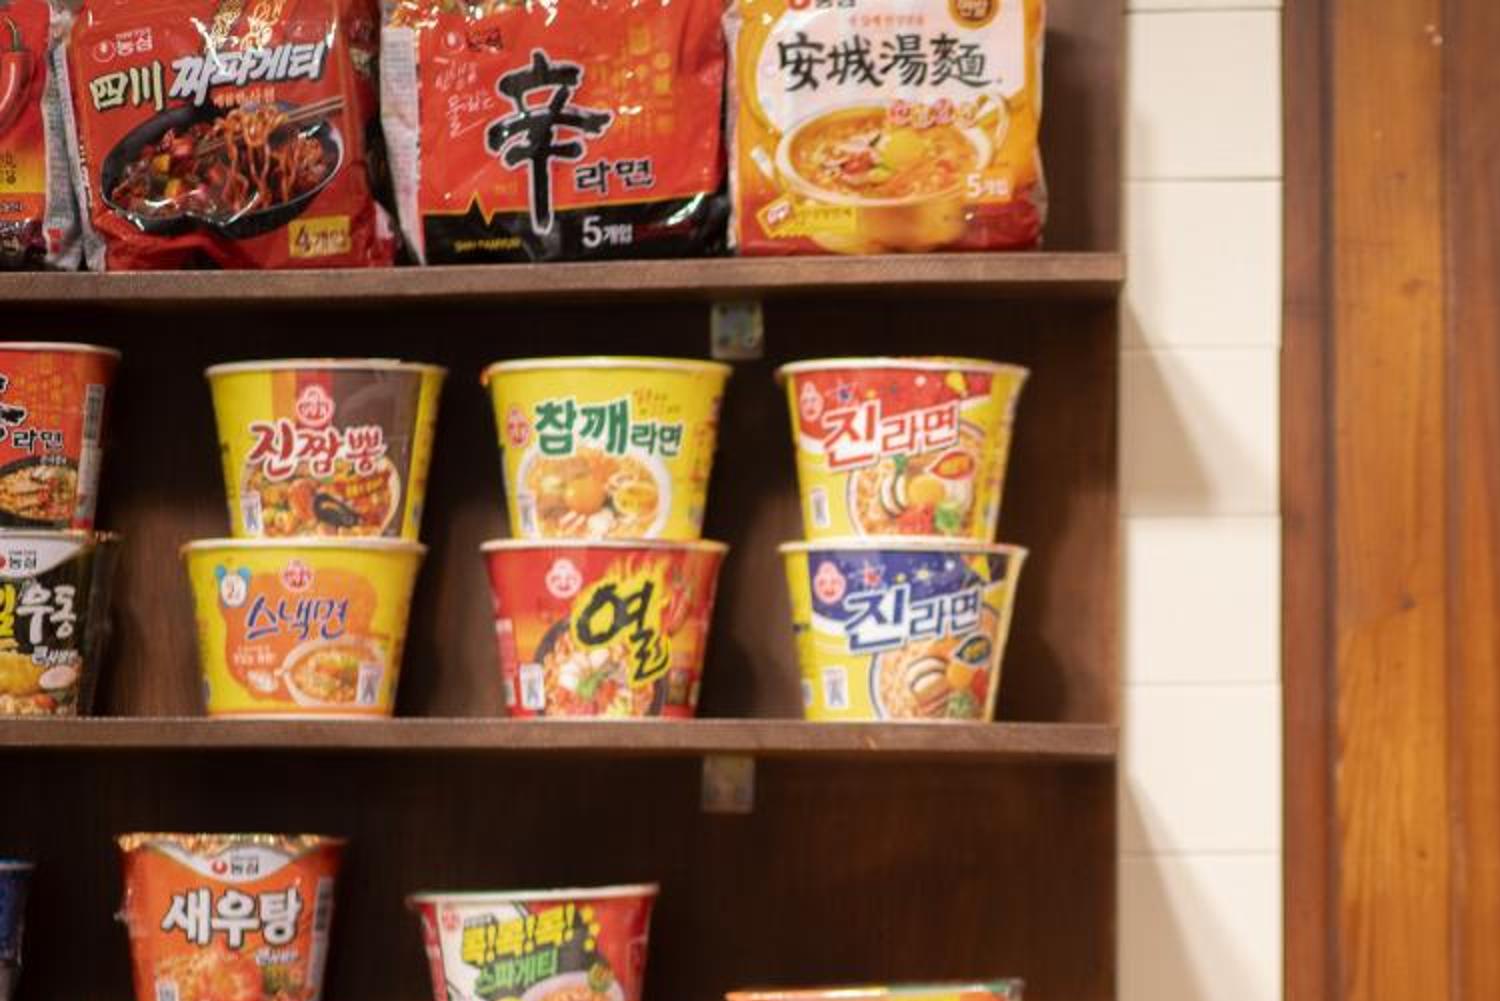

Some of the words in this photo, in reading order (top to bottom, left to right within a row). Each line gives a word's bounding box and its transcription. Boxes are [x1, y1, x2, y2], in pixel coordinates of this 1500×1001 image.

[88, 60, 164, 111] 四川
[168, 41, 333, 106] 짜파게티
[776, 31, 993, 93] 安城湯麵
[484, 47, 622, 236] 辛
[575, 158, 656, 194] 라면
[581, 216, 634, 248] 5개입
[12, 428, 64, 454] 라면
[249, 417, 390, 482] 진짬뽕
[823, 401, 959, 471] 진라면
[247, 596, 349, 641] 스낵면
[576, 580, 669, 682] 열
[844, 585, 982, 654] 진라면
[159, 886, 303, 950] 새우탕
[474, 946, 560, 997] 스파게티
